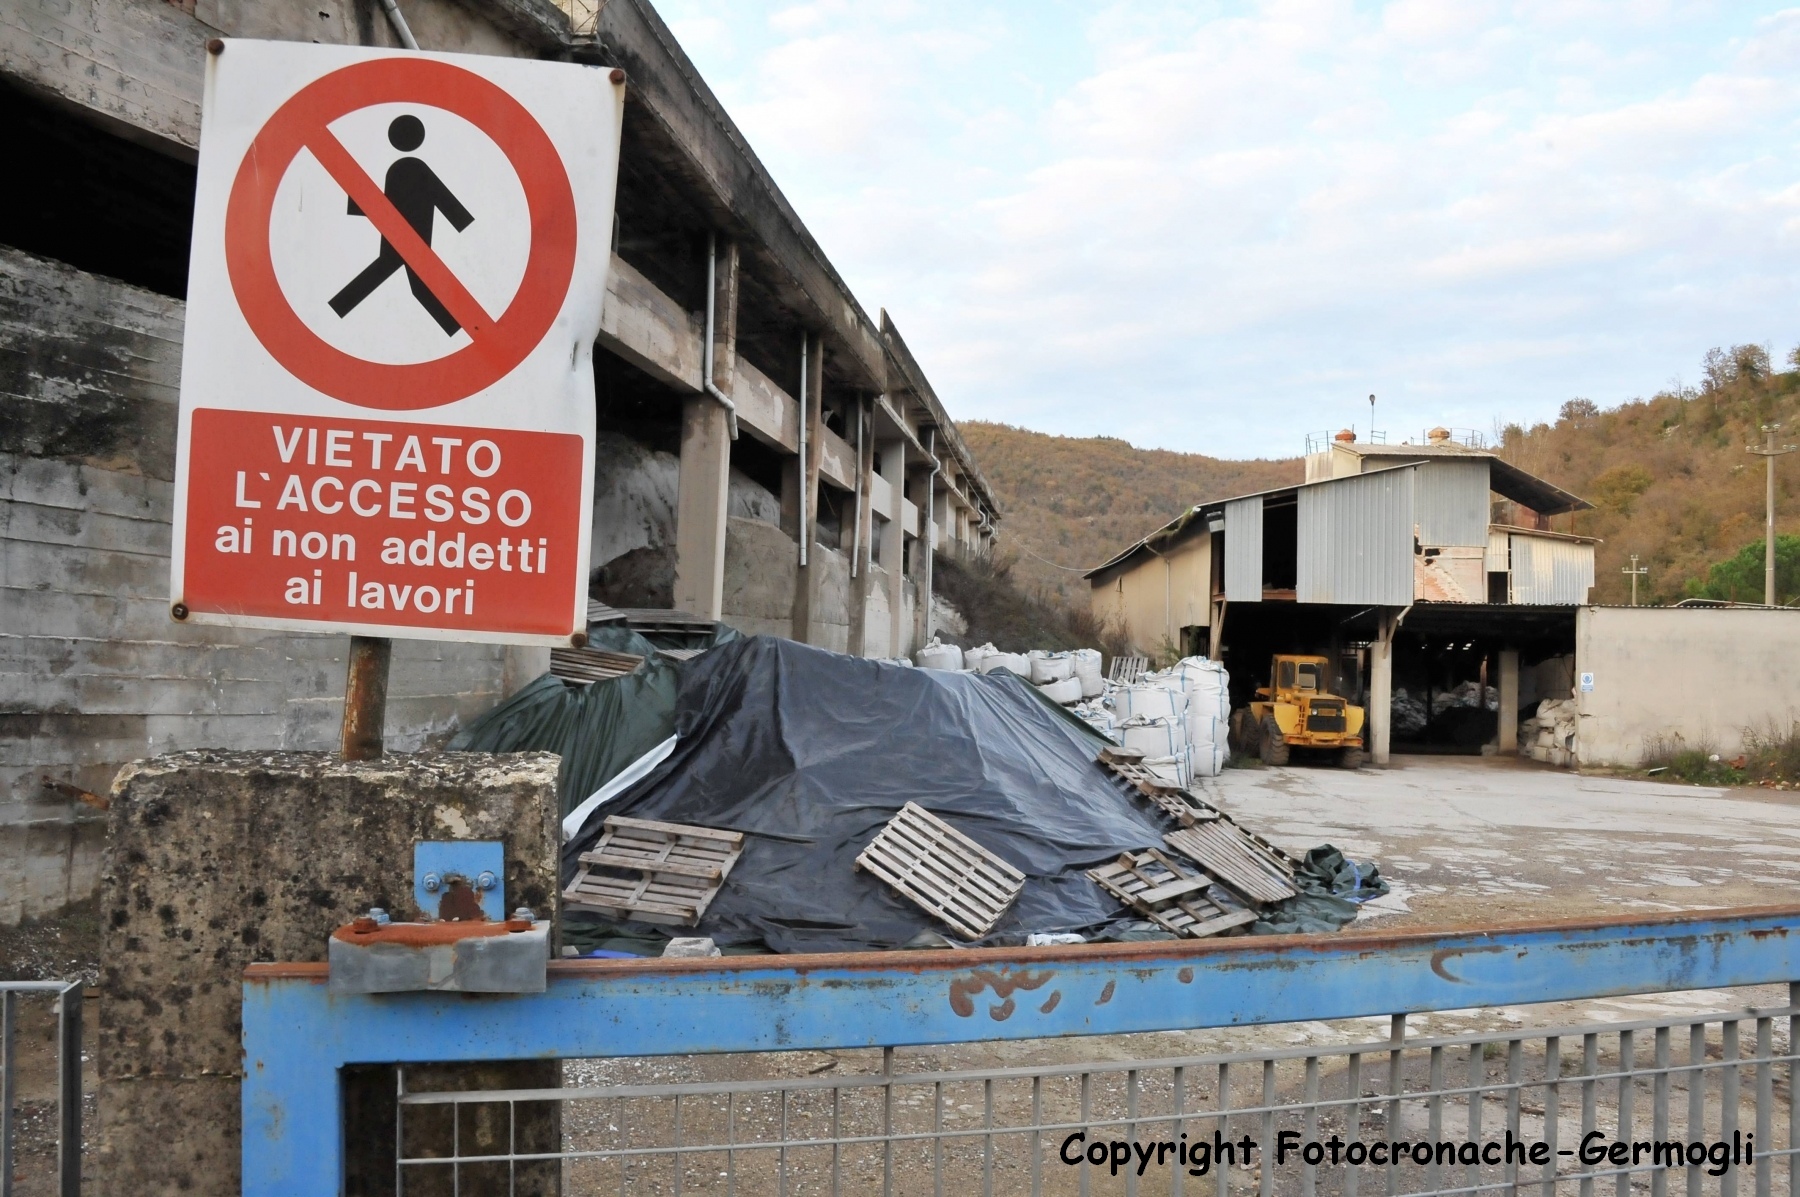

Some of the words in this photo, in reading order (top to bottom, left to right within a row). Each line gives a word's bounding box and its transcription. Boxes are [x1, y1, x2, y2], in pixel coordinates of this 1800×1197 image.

[272, 425, 502, 478] VIETATO
[214, 517, 253, 554] ai
[272, 529, 356, 562] non
[380, 530, 547, 574] addetti
[284, 568, 322, 605] ai
[347, 571, 475, 615] lavori
